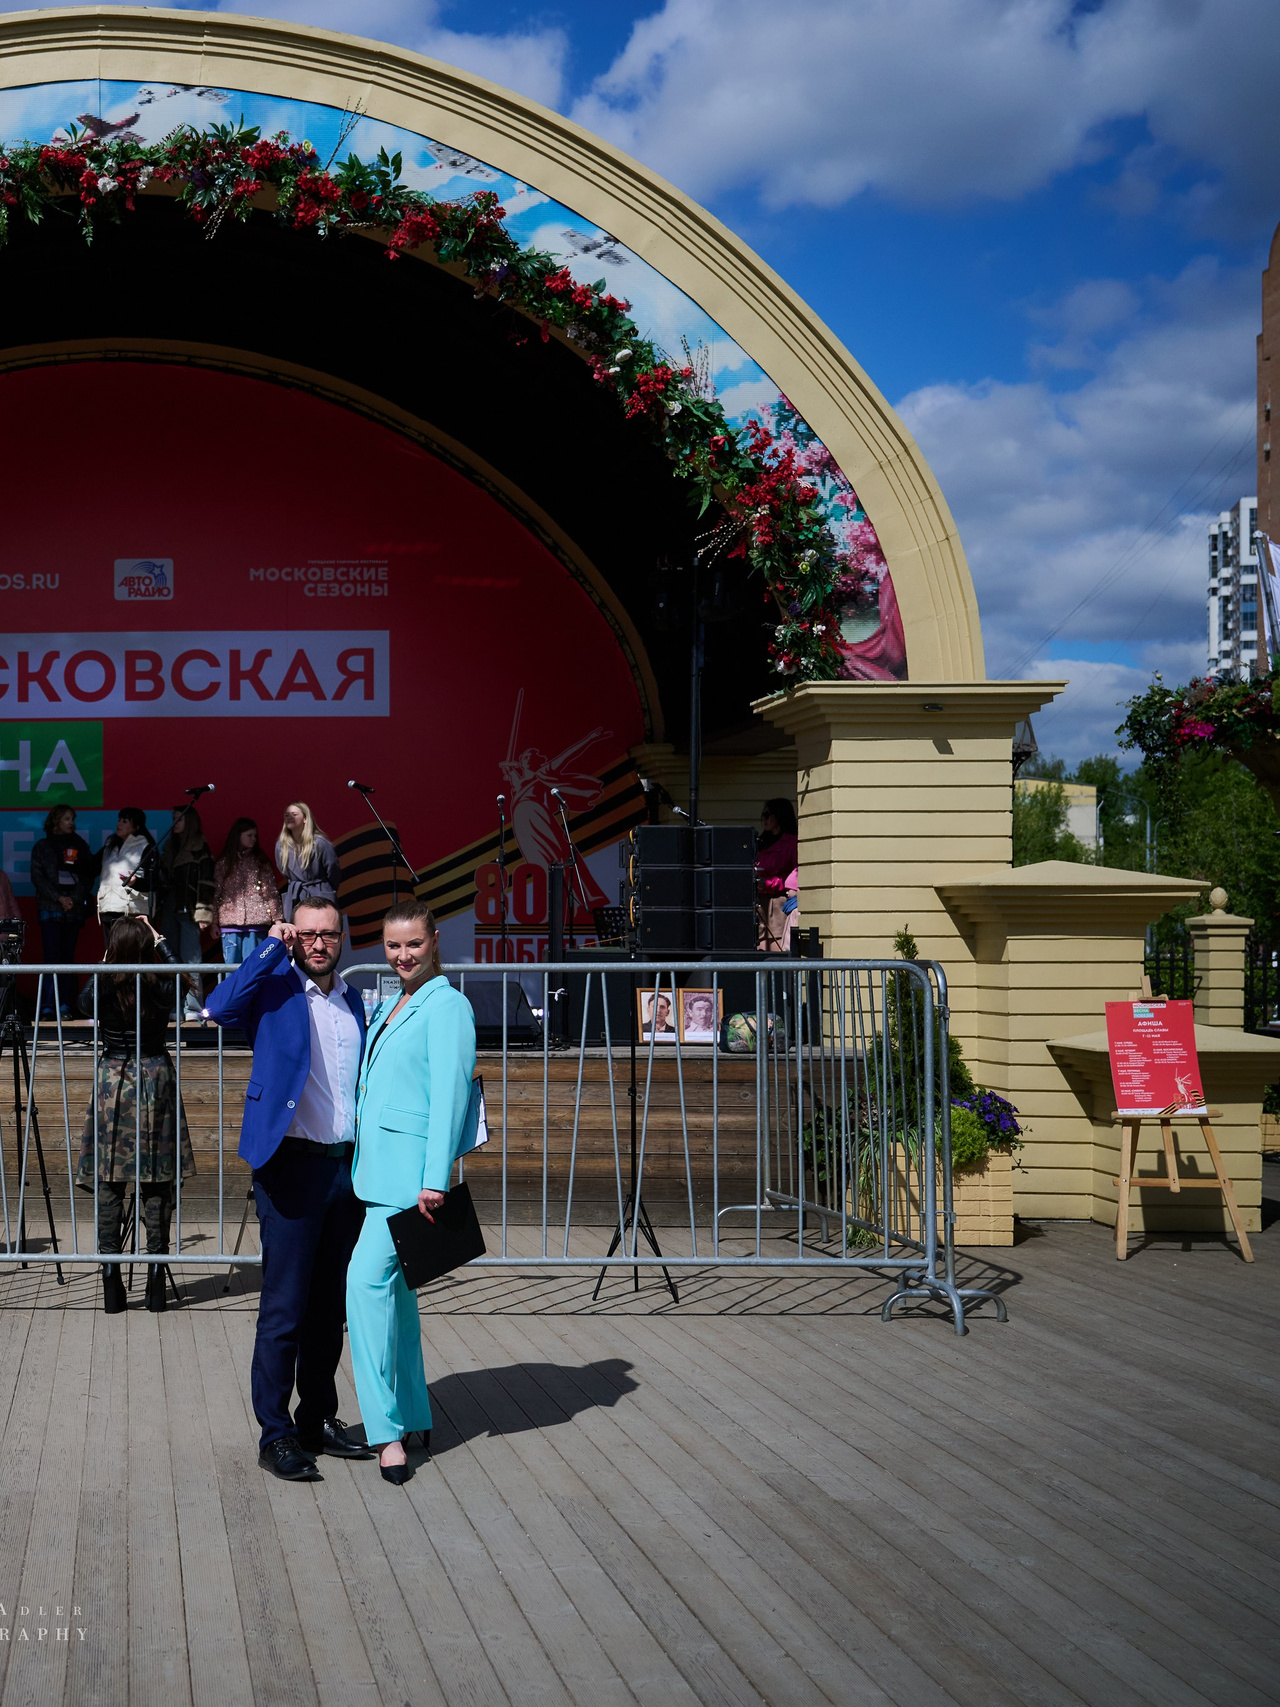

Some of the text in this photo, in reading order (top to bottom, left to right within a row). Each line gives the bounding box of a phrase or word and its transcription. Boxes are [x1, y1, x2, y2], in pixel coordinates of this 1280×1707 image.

[249, 567, 389, 581] МОСКОВСКИЕ
[118, 576, 152, 587] АВТО
[128, 586, 171, 597] РАДИО
[303, 582, 389, 597] СЕЗОНЫ
[474, 863, 547, 924] 80
